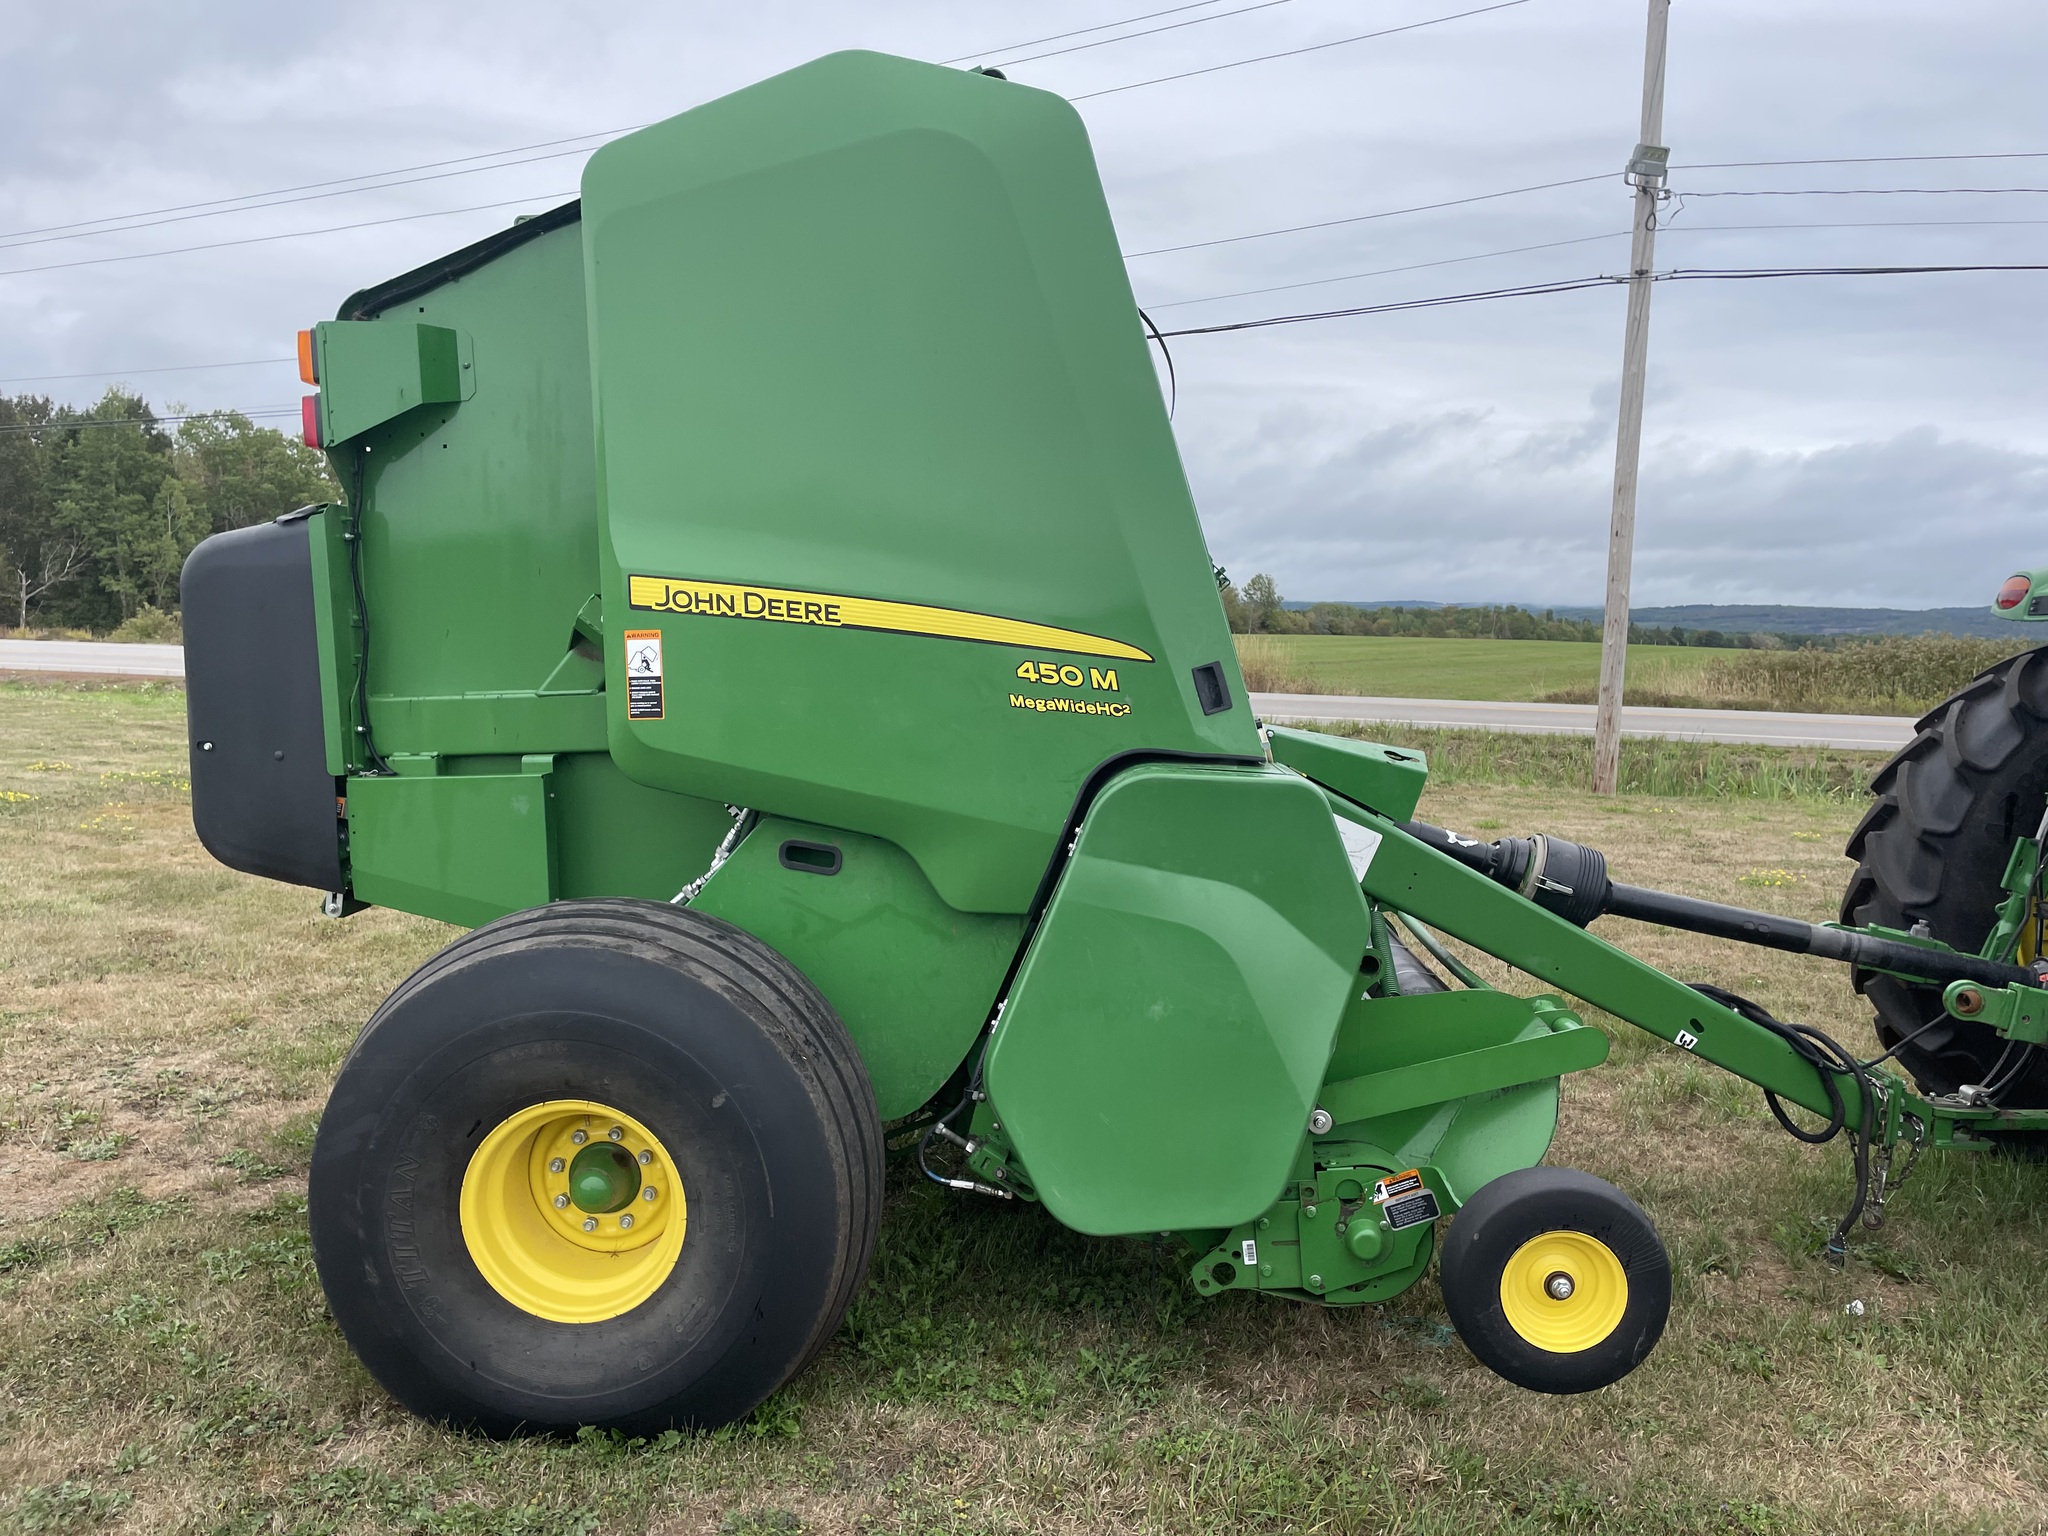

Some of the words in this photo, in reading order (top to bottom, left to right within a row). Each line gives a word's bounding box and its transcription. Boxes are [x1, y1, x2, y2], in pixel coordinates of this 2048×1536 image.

[654, 584, 736, 613] JOHN
[743, 591, 842, 623] DEERE
[1016, 660, 1084, 687] 450
[1089, 666, 1120, 692] M
[386, 1153, 432, 1291] TITAN
